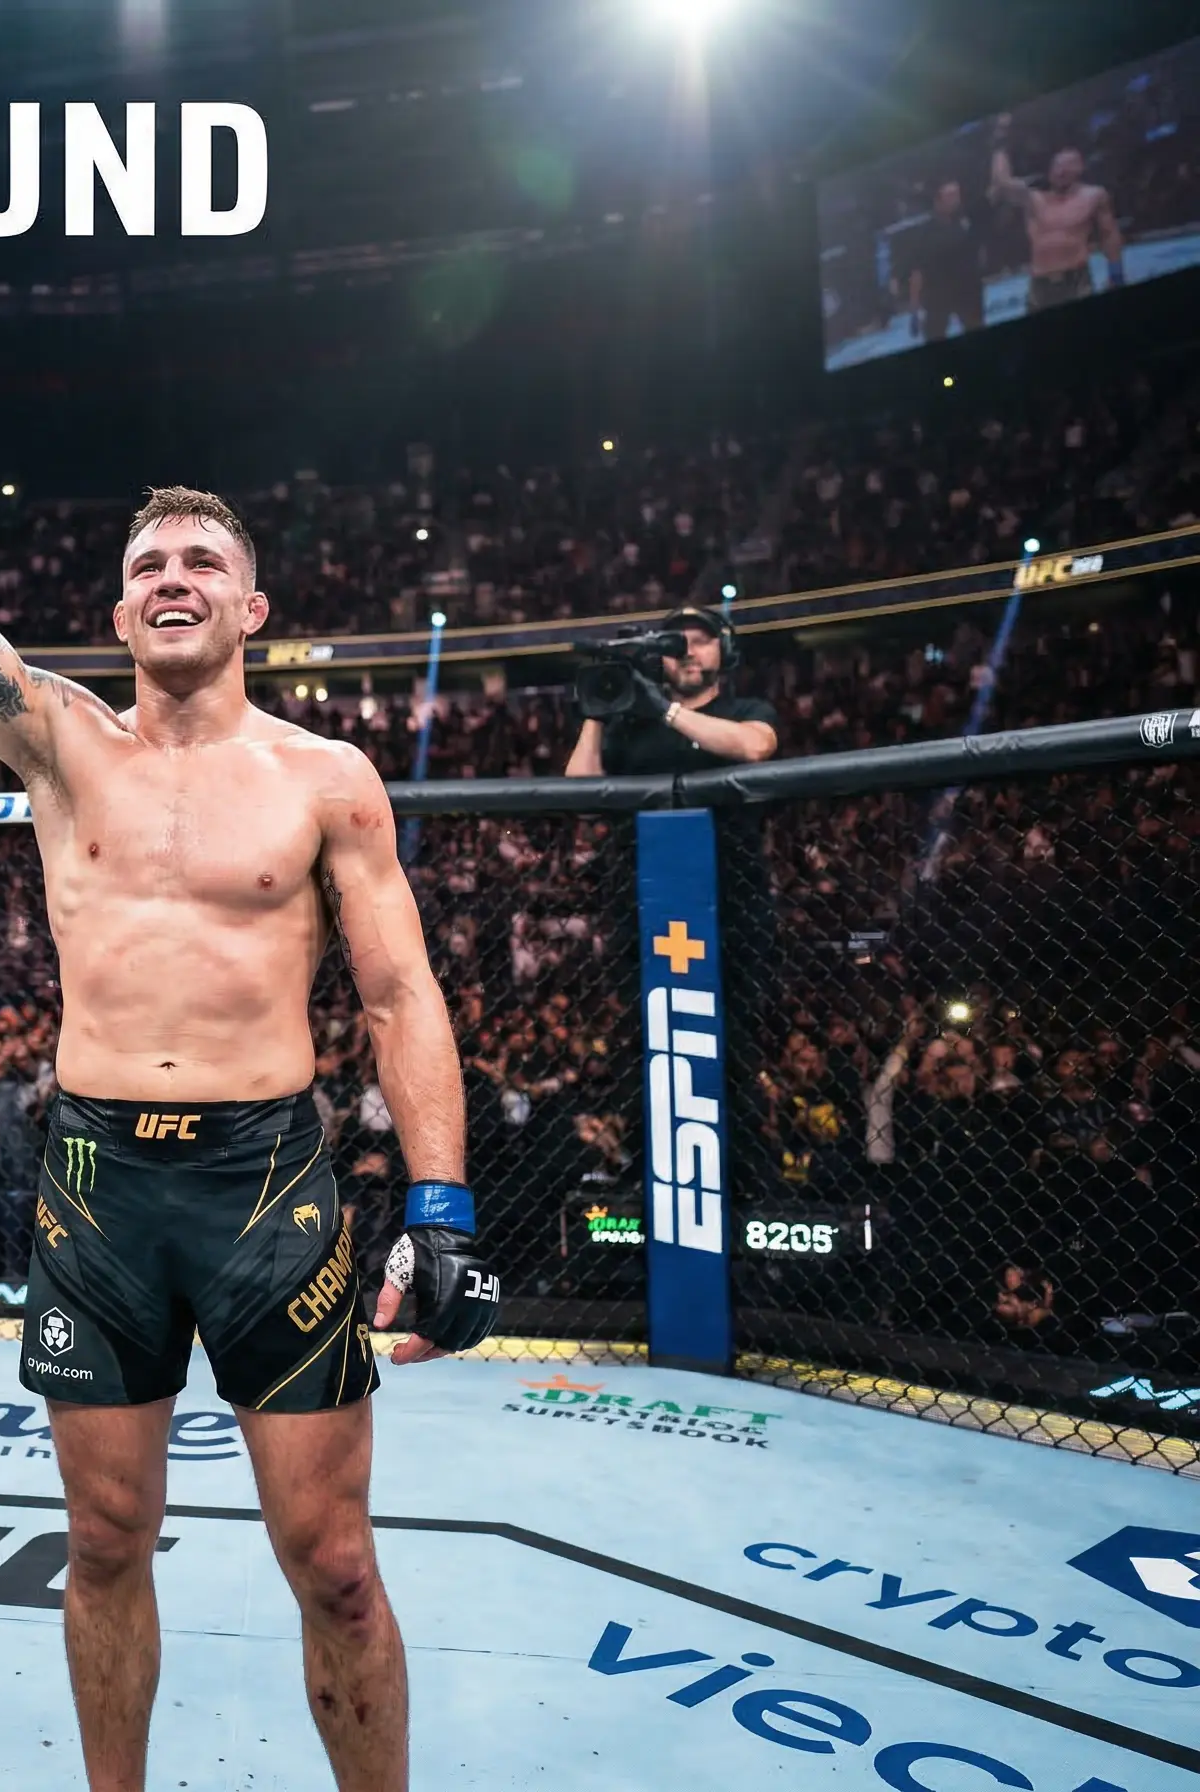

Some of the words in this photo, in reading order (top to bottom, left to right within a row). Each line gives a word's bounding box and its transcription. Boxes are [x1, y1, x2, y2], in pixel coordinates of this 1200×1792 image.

[135, 1113, 201, 1139] UFC
[464, 1269, 500, 1303] UFC
[522, 1388, 784, 1424] DRAFT
[744, 1542, 1200, 1689] crypto
